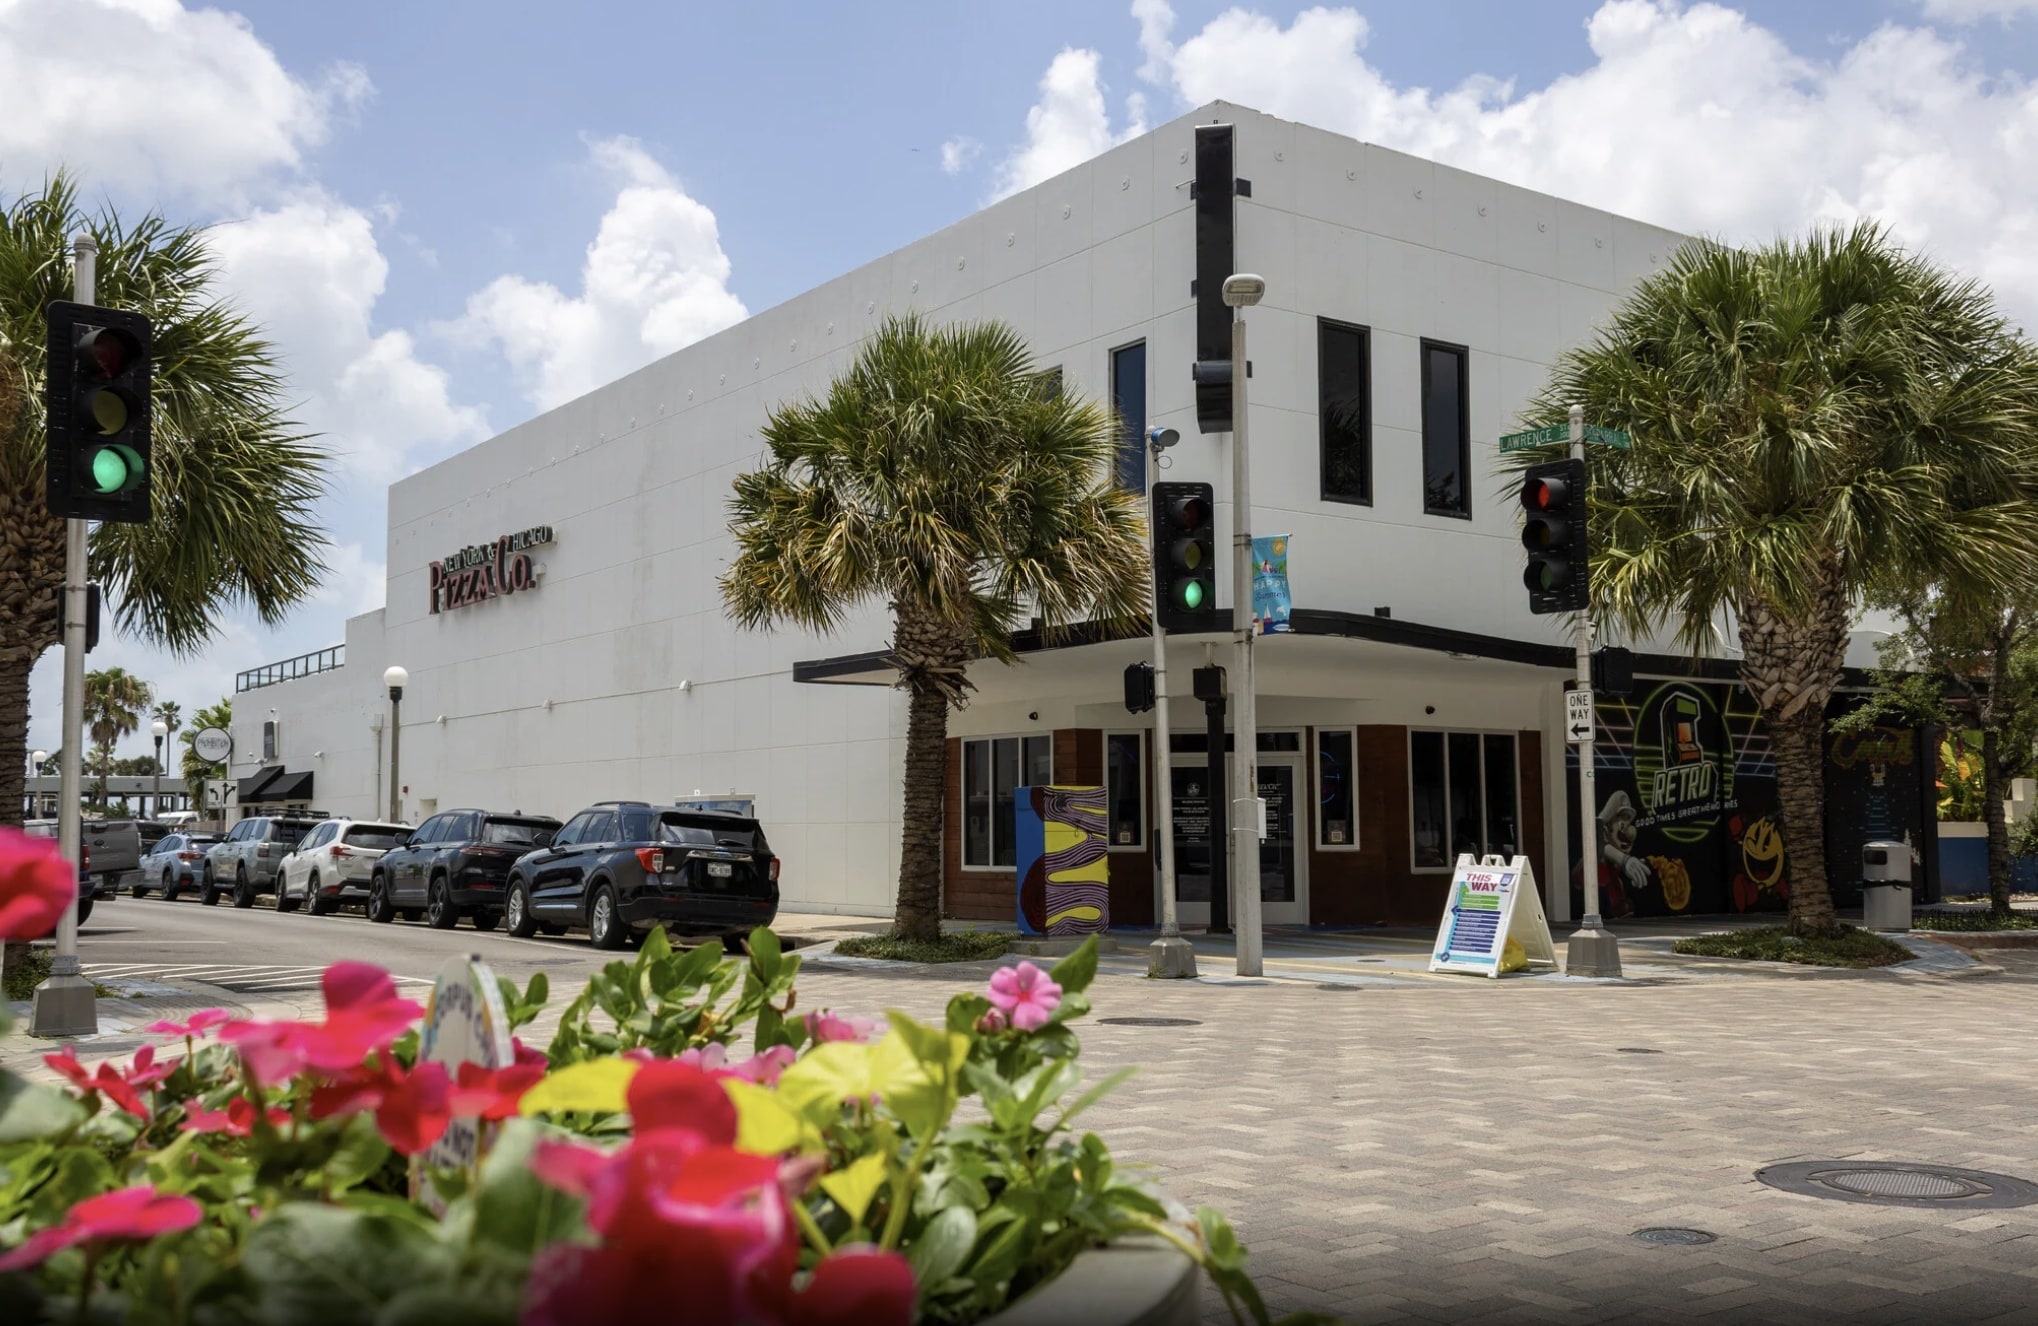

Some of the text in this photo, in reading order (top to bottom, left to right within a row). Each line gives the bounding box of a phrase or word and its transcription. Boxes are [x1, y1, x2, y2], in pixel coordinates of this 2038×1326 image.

[1501, 428, 1553, 451] LAWRENCE
[443, 556, 462, 573] NEW
[462, 545, 485, 568] YORK
[487, 543, 497, 560] &
[429, 561, 496, 615] PIZZA
[1254, 579, 1286, 590] HAPPY
[1570, 694, 1589, 707] ONE
[1570, 709, 1589, 721] WAY
[1654, 765, 1713, 807] RETRO
[1635, 816, 1655, 828] GOOD
[1656, 811, 1676, 823] TIMES
[1678, 807, 1700, 818] GREAT
[1466, 873, 1493, 882] THIS
[1471, 882, 1498, 892] WAY
